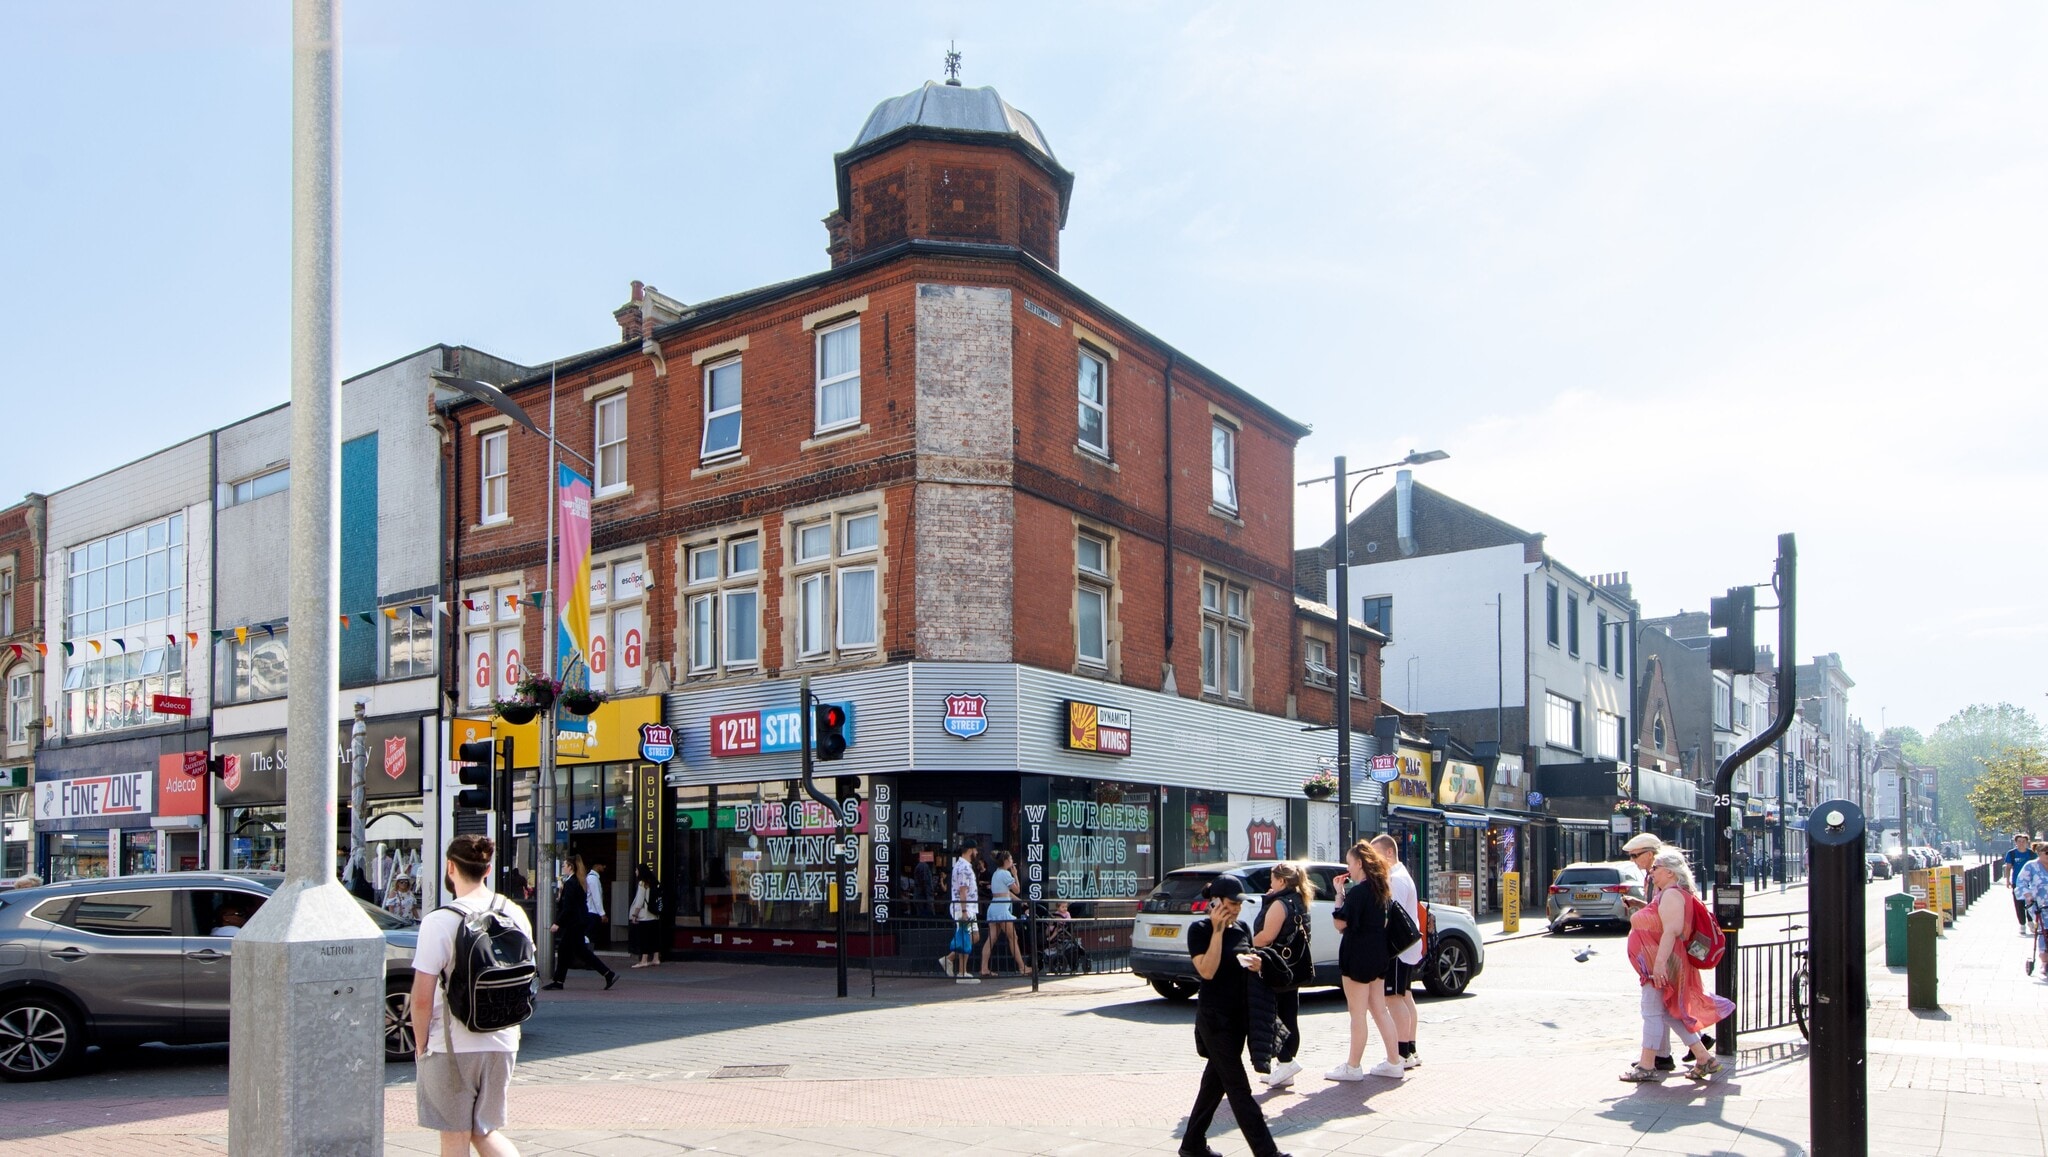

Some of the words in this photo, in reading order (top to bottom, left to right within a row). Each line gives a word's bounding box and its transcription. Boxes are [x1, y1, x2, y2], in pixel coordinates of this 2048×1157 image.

[160, 701, 186, 710] Adecco
[952, 700, 977, 715] 12TH
[951, 719, 981, 731] STREET
[1099, 709, 1128, 726] DYNAMITE
[649, 730, 667, 743] 12TH
[719, 717, 756, 751] 12TH
[766, 712, 817, 746] STR
[1099, 731, 1128, 751] WINGS
[251, 751, 272, 771] The
[337, 743, 372, 767] Ary
[648, 747, 670, 757] STREET
[1375, 758, 1391, 768] 12TH
[166, 777, 197, 793] Adecco
[62, 781, 99, 816] FONE
[1714, 794, 1731, 806] 25
[647, 776, 655, 844] BUBBLE
[1057, 799, 1149, 832] BURGERS
[1025, 804, 1046, 901] WINGS
[1057, 835, 1127, 864] WINGS
[1254, 832, 1271, 854] 12TH
[874, 784, 890, 923] BURGERS
[1056, 870, 1138, 899] SHAKES
[1509, 879, 1517, 896] BIG
[1509, 900, 1517, 925] NEWS
[321, 945, 354, 956] ALTRON
